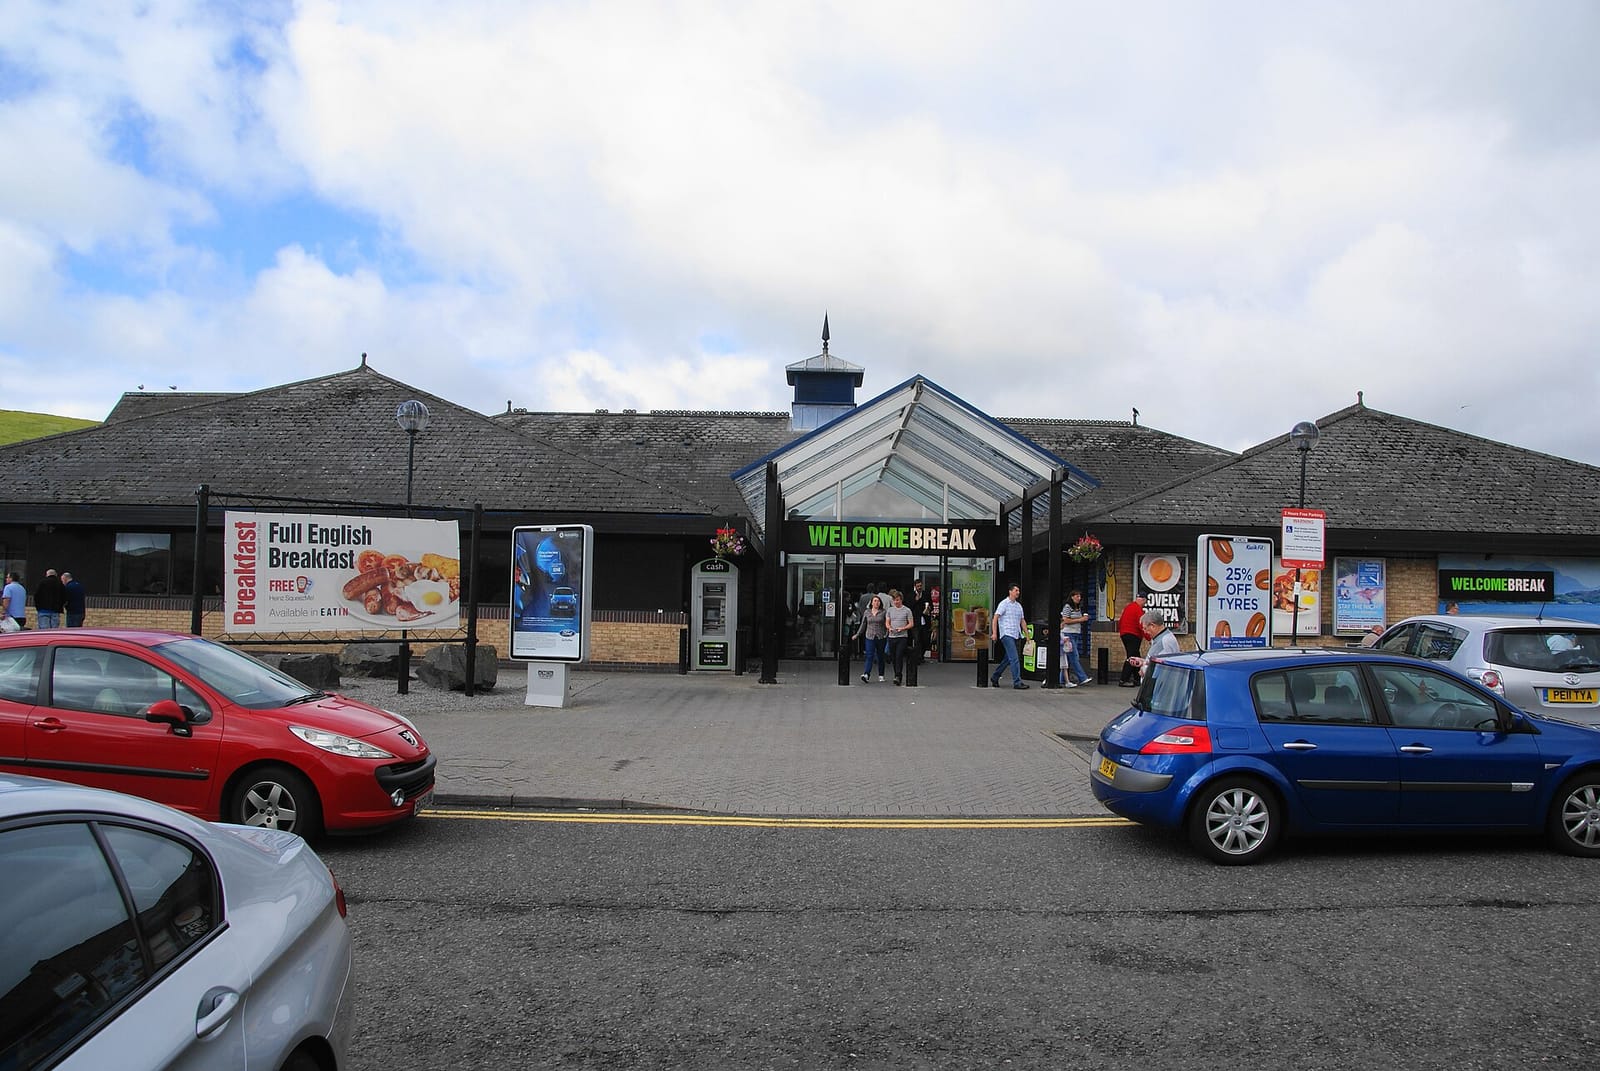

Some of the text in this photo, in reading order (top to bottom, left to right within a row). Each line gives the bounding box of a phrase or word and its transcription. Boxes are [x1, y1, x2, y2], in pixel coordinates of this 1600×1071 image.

[268, 522, 302, 544] Full
[308, 523, 372, 546] English
[808, 524, 977, 551] WELCOMEBREAK
[268, 547, 355, 570] Breakfast
[233, 521, 257, 625] Breakfast
[1225, 567, 1253, 582] 25%
[269, 580, 295, 592] FREE
[1226, 583, 1252, 596] OFF
[1451, 577, 1545, 592] WELCOMEBREAK
[1144, 593, 1181, 607] OVELY
[269, 608, 309, 617] Available
[310, 608, 319, 617] in
[1573, 690, 1592, 702] TYA
